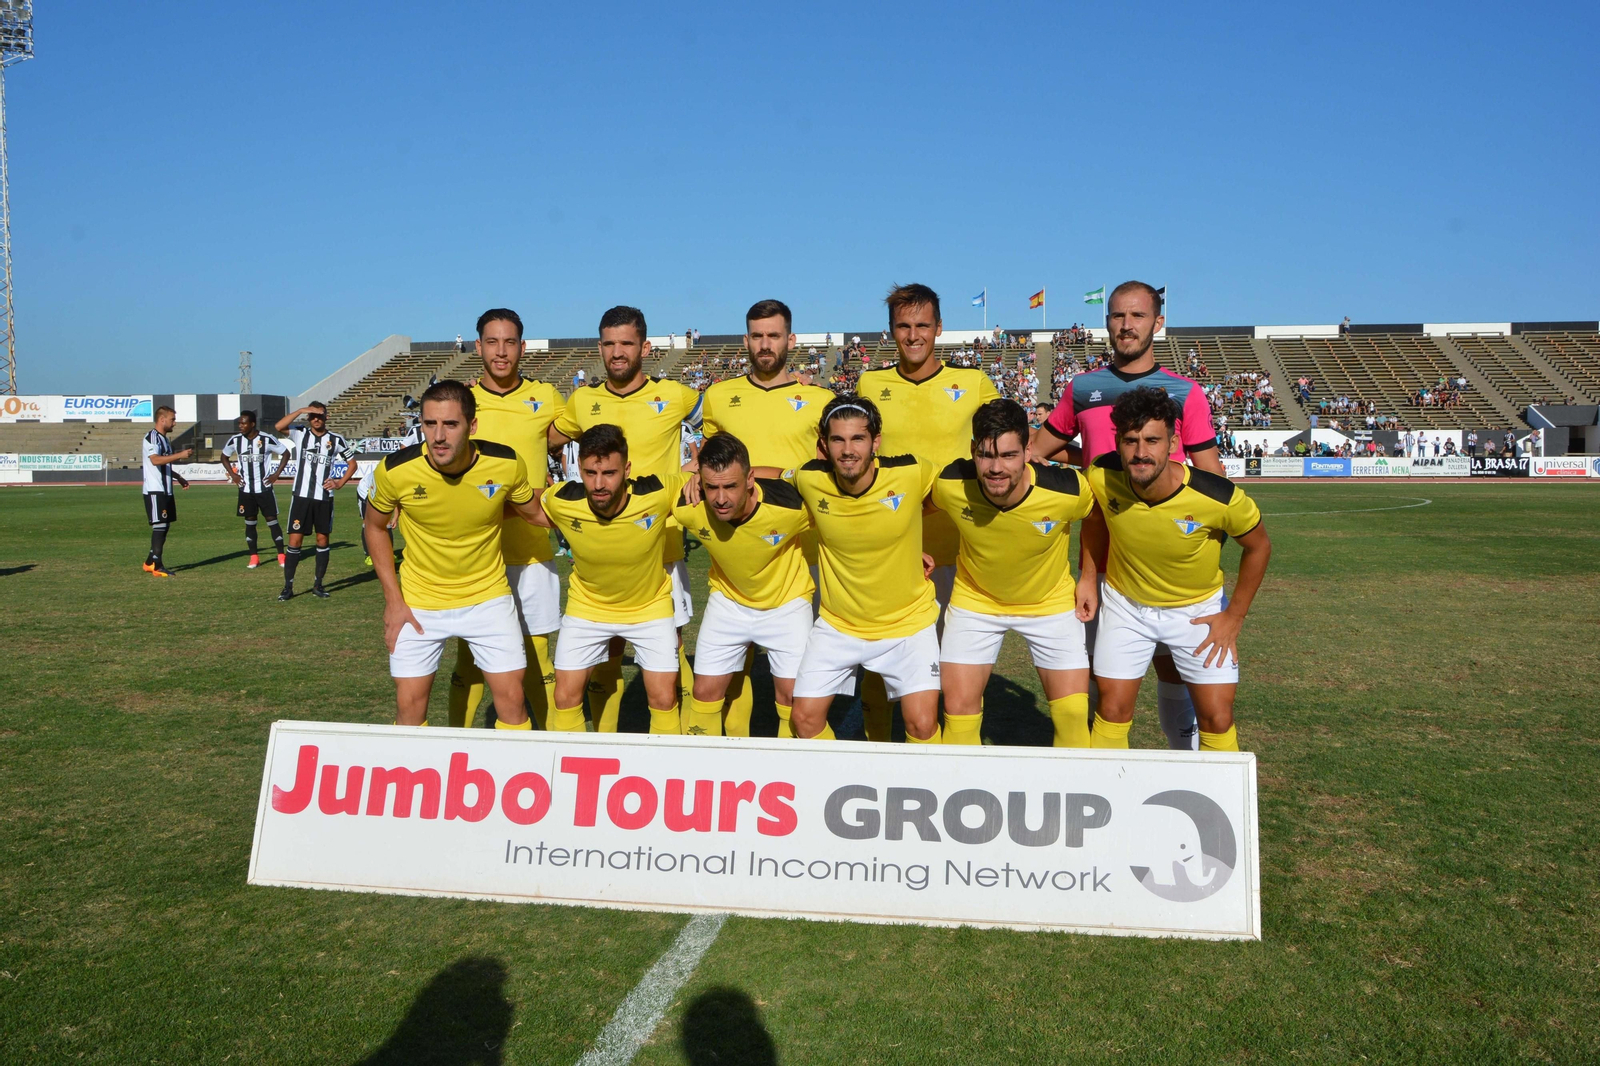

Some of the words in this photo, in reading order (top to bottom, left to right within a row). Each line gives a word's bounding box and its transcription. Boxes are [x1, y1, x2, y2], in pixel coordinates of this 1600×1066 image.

[64, 398, 139, 409] EUROSHIP
[20, 455, 62, 463] INDUSTRIAS
[79, 455, 102, 463] LACSE
[1412, 458, 1444, 467] MIPAN
[1484, 458, 1518, 470] BRASA
[1519, 458, 1529, 469] 17
[1352, 466, 1389, 474] FERRETERIA
[1391, 466, 1410, 474] MENA
[1534, 458, 1587, 475] Universal
[272, 744, 551, 827] Jumbo
[560, 756, 798, 837] Tours
[823, 784, 1112, 848] GROUP
[505, 839, 736, 876] International
[750, 851, 930, 891] Incoming
[945, 859, 1112, 893] Network
